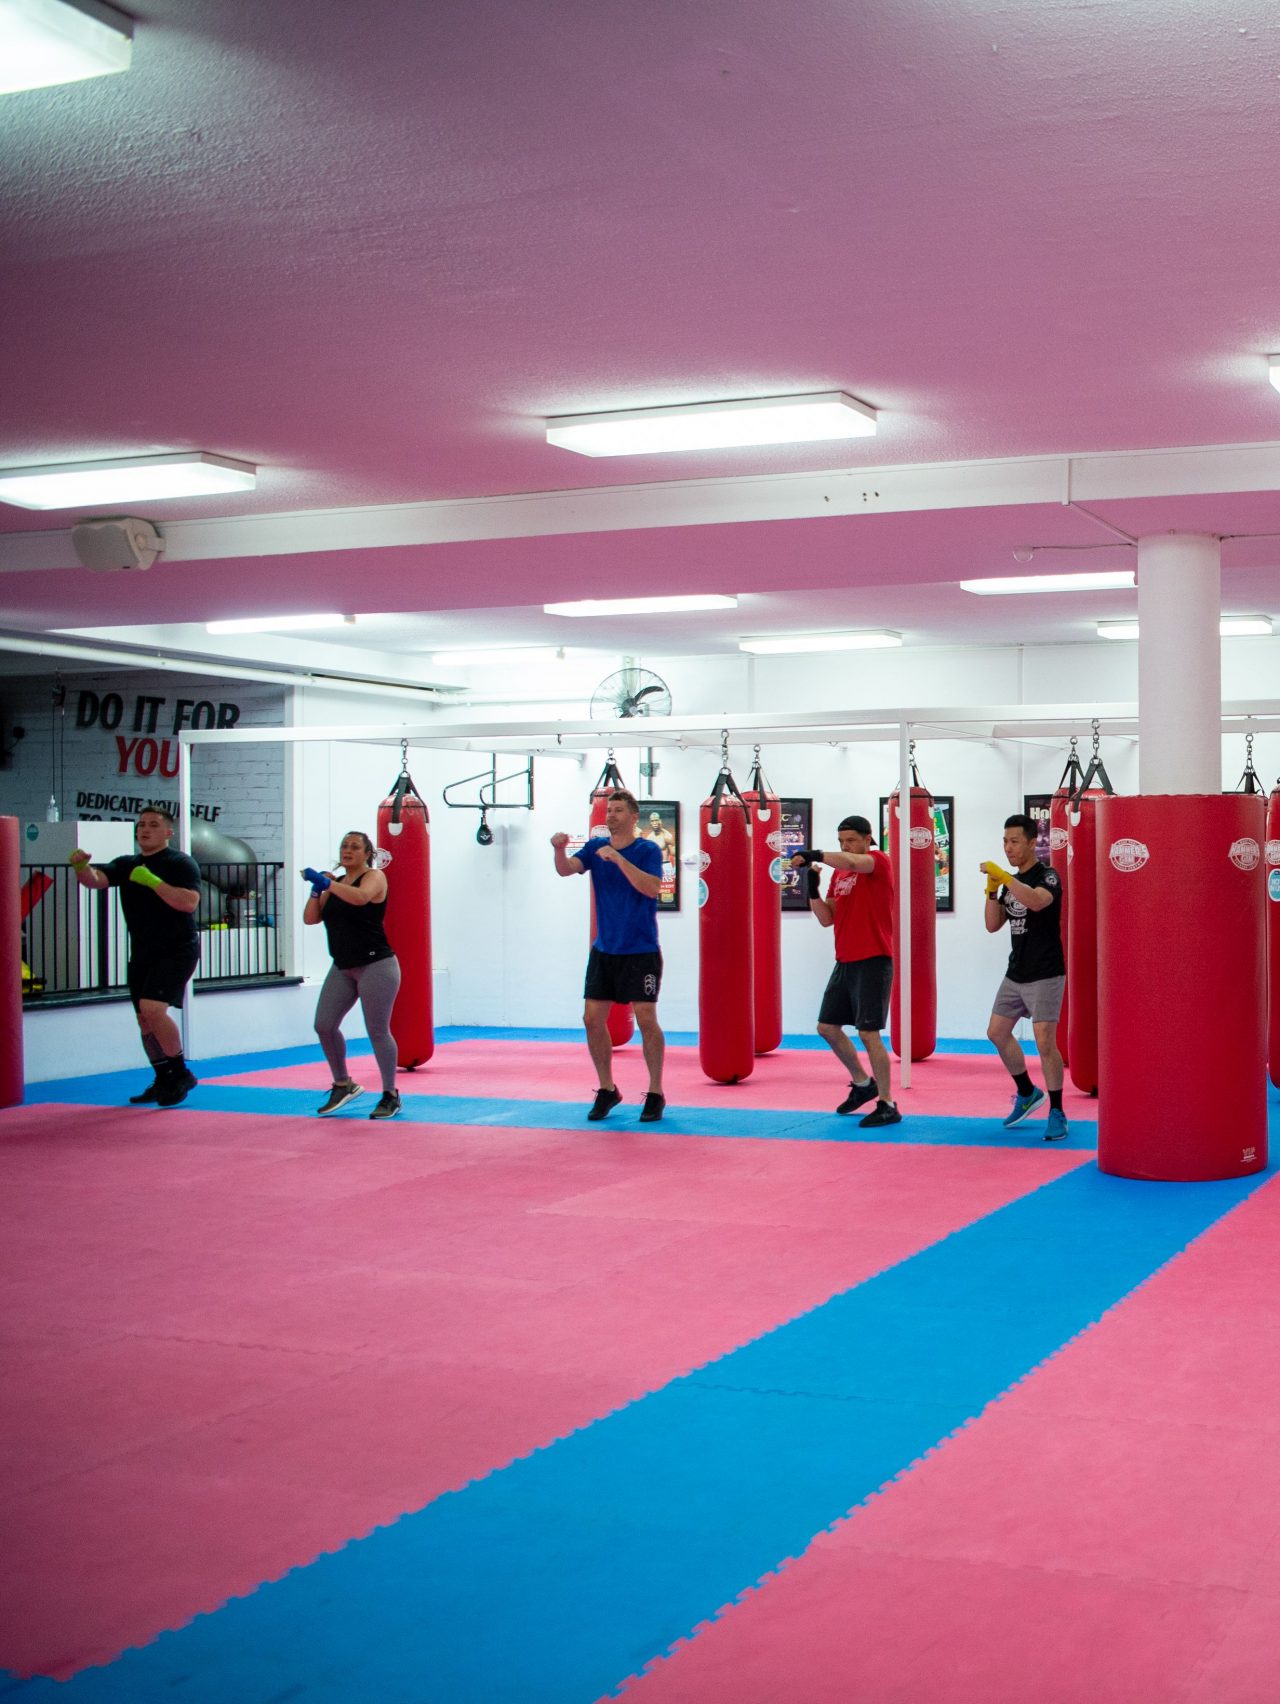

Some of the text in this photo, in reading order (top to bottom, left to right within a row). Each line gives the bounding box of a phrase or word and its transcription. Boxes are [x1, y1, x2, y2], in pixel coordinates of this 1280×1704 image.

[76, 690, 241, 736] DO IT FOR
[116, 735, 194, 779] YOU
[77, 791, 144, 815] DEDICATE
[147, 798, 222, 823] YOUSELF
